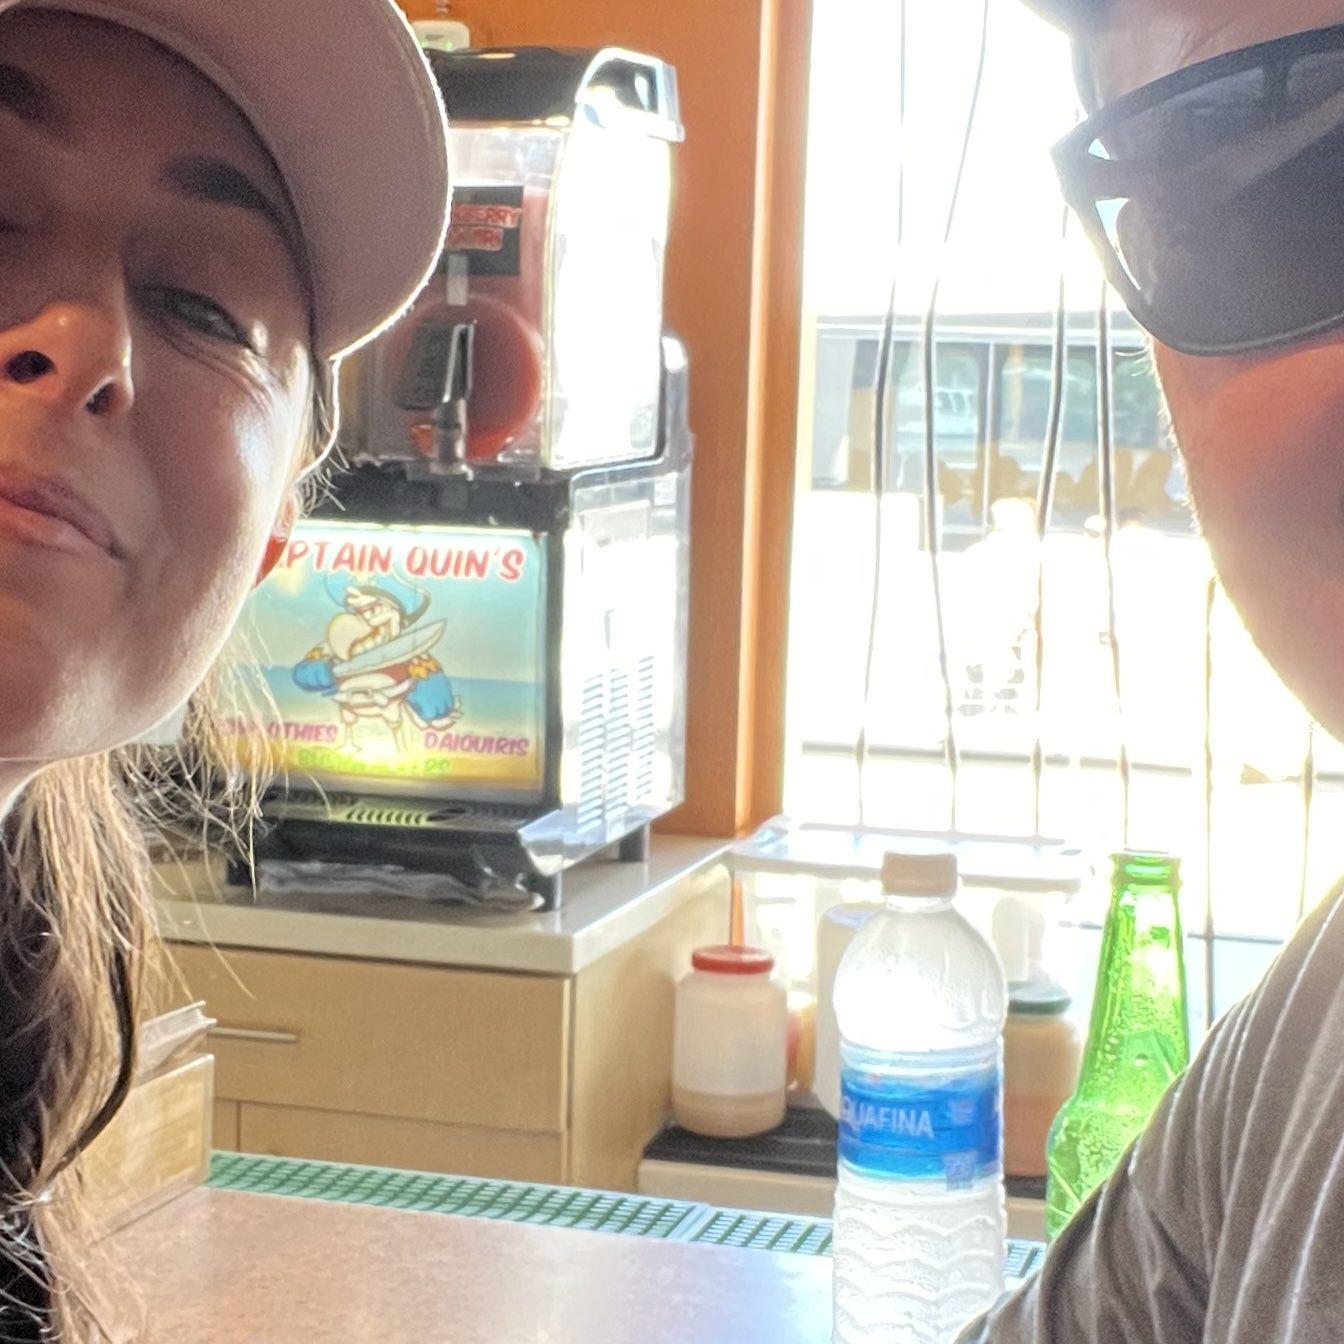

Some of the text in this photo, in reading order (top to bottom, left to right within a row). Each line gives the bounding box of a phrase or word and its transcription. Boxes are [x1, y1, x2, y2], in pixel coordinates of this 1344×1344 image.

[279, 540, 524, 581] PTAIN QUIN'S
[423, 731, 530, 756] DAIQUIRIS
[839, 1095, 936, 1140] QUAFINA
